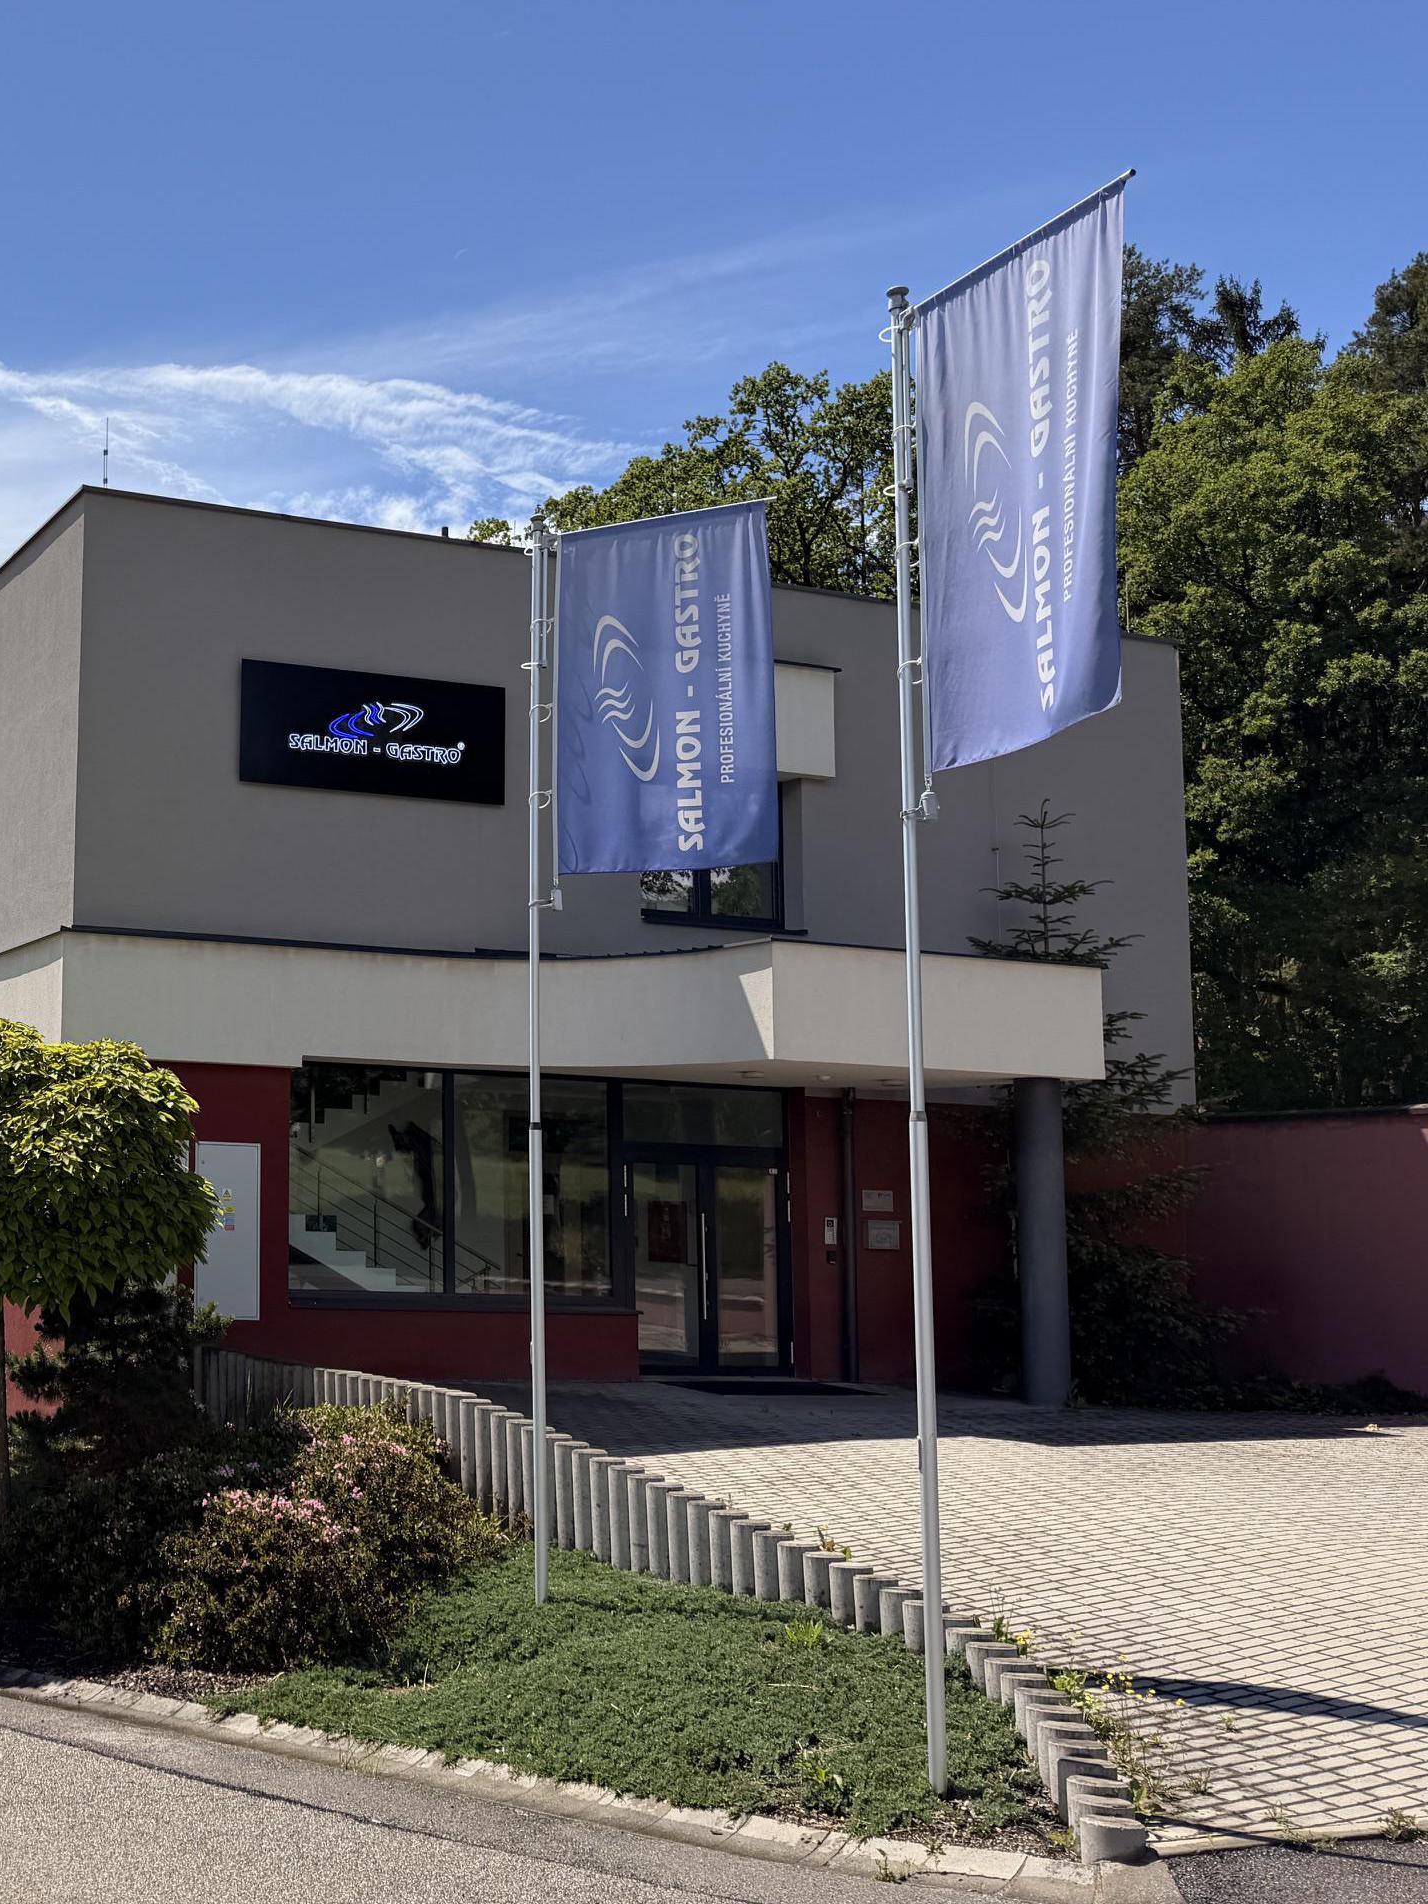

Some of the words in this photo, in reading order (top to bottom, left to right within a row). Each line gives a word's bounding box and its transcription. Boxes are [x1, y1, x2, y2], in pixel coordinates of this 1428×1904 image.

[1025, 259, 1053, 458] GASTRO
[673, 532, 702, 674] GASTRO
[714, 593, 732, 663] KUCHYNĚ
[1032, 505, 1056, 711] SALMON
[289, 734, 368, 755] SALMON
[675, 710, 704, 852] SALMON
[715, 667, 735, 784] PROFESIONÁLNÍ
